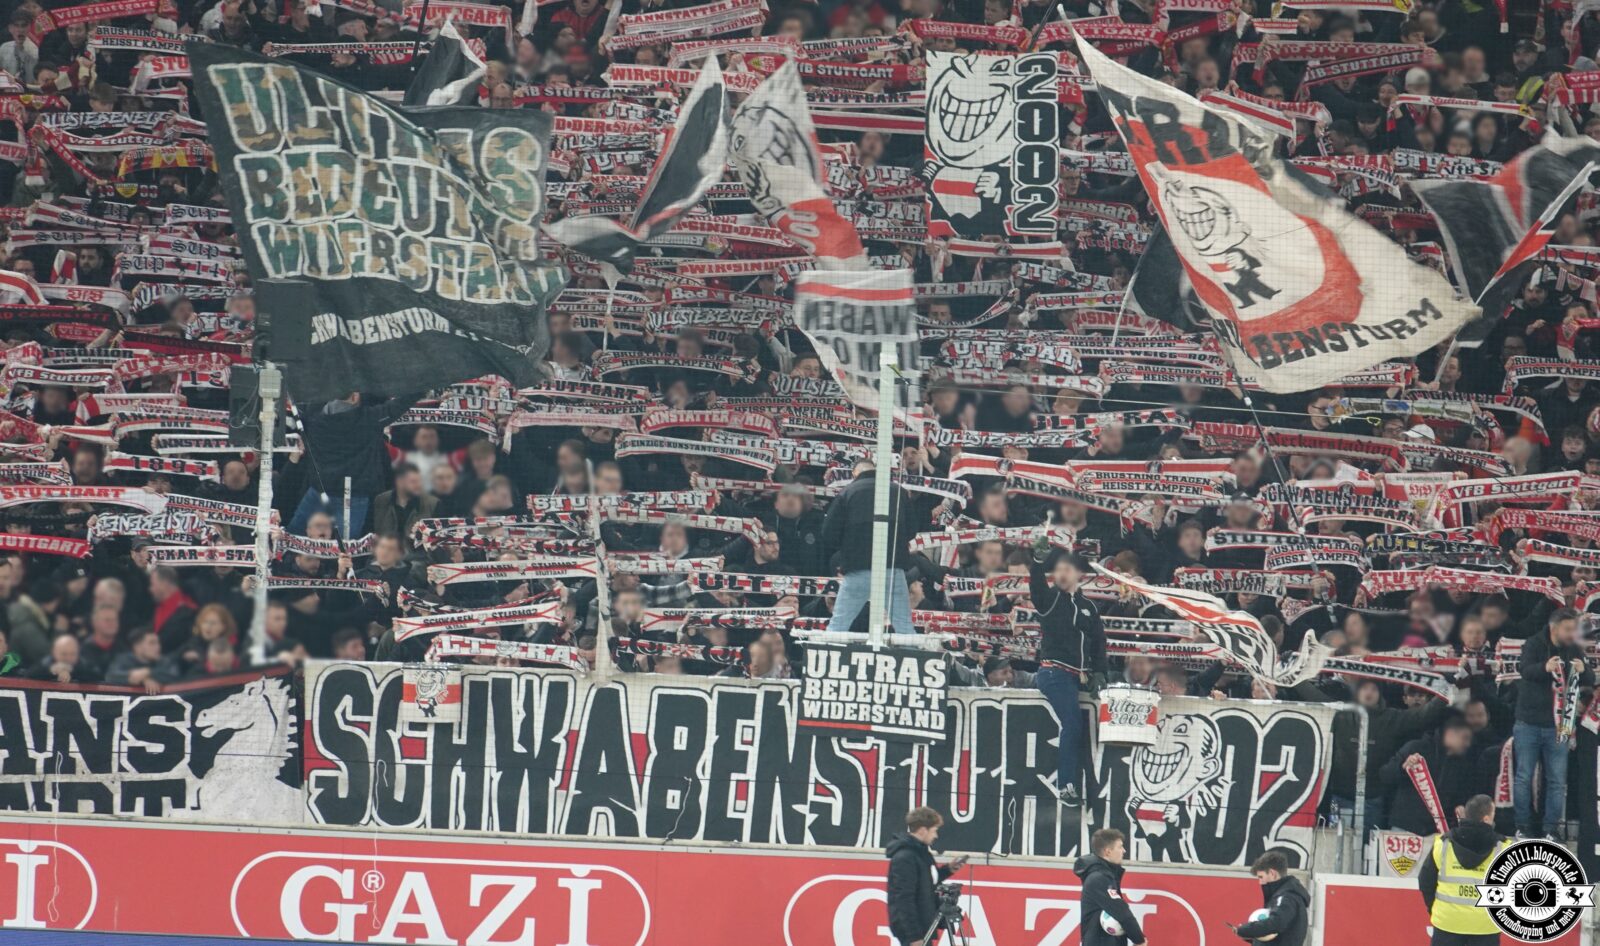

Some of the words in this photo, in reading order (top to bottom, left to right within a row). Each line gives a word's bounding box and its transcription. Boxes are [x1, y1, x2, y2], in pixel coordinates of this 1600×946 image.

[102, 38, 148, 49] HEISST
[676, 36, 750, 51] NNSTATTER
[817, 64, 895, 80] STUTTGART
[544, 86, 611, 99] STUTTGA
[1514, 357, 1566, 367] RUSTRING
[1143, 373, 1184, 383] HEISST
[1102, 481, 1142, 491] HEISST
[1164, 475, 1211, 487] TRAGEN
[168, 496, 225, 512] RUSTRING
[0, 536, 83, 555] TUTTGART
[804, 646, 947, 689] ULTRAS
[803, 676, 946, 710] BEDEUTET
[802, 699, 946, 731] WIDERSTAND
